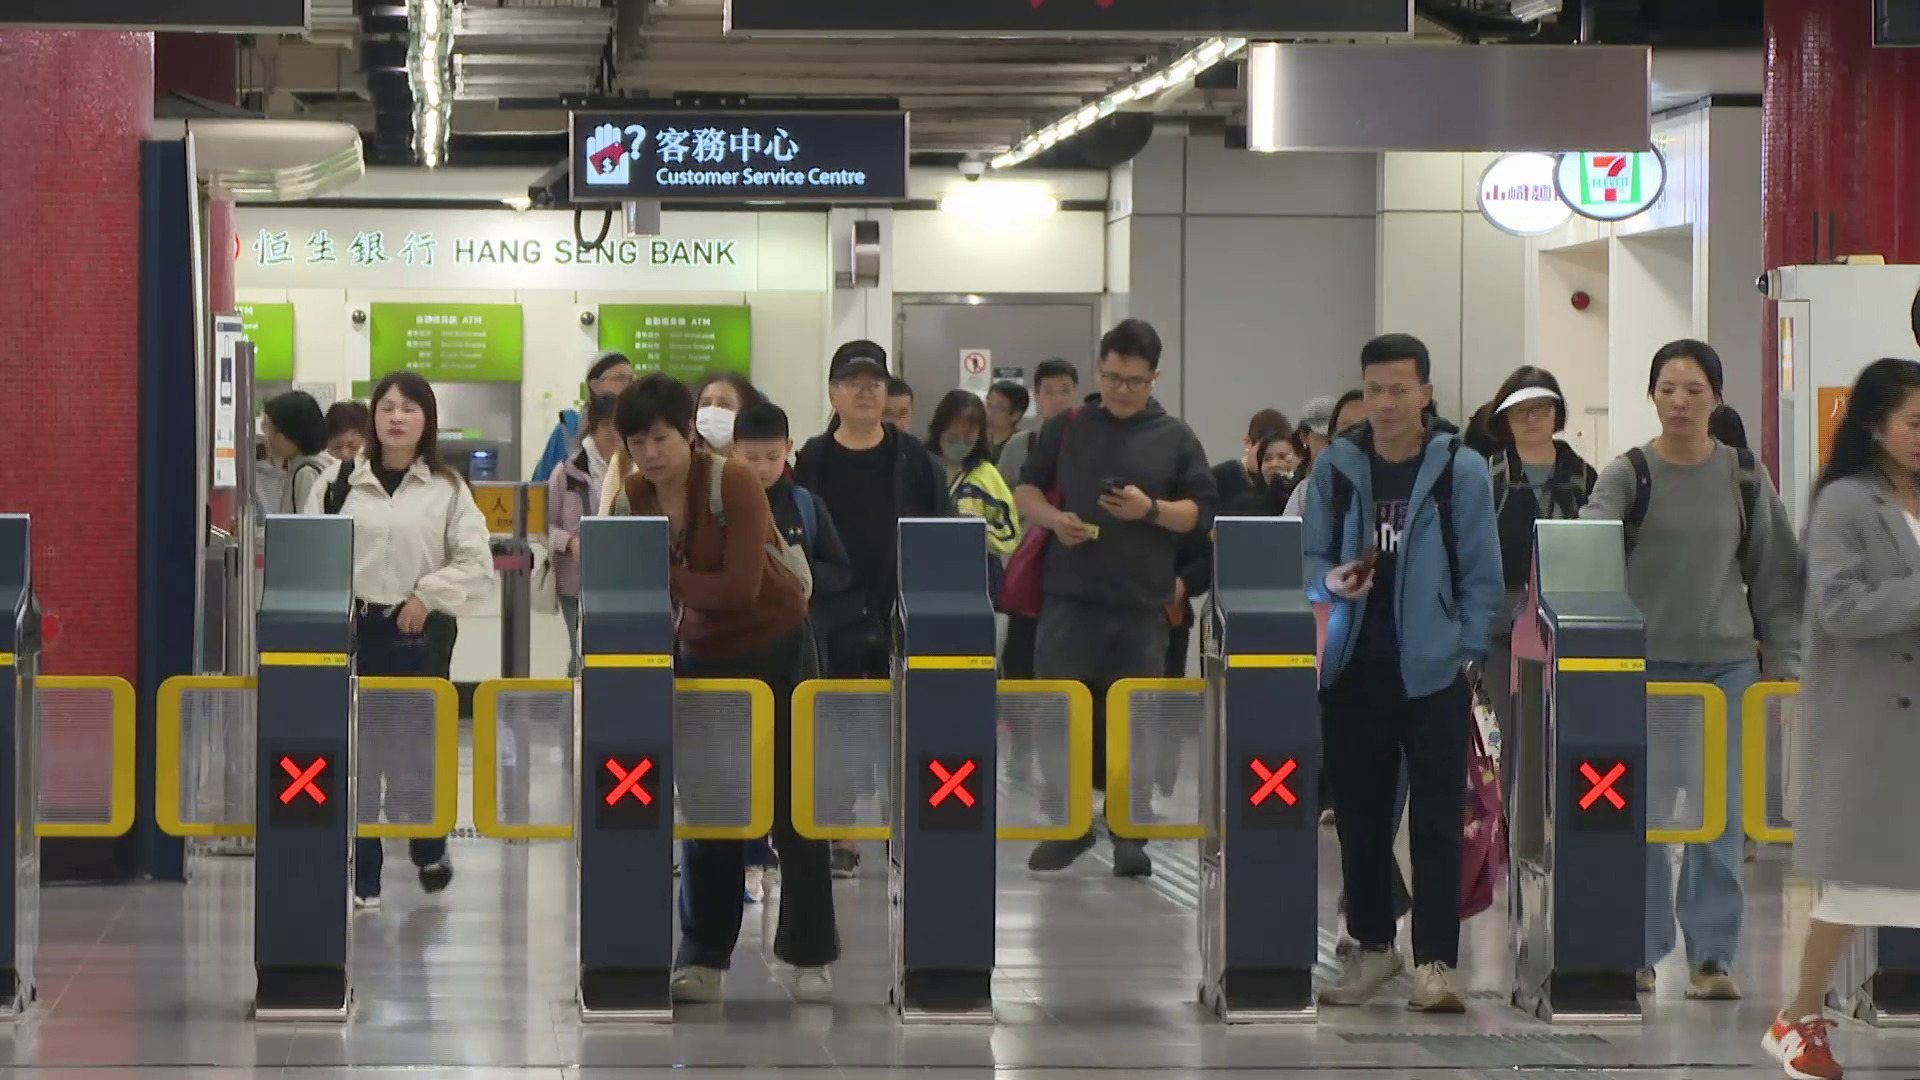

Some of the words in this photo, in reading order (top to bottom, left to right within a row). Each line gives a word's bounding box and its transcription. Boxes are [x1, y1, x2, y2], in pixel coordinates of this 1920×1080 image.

[655, 127, 799, 163] 客務中心
[656, 168, 739, 185] Customer
[743, 168, 803, 185] Service
[808, 168, 866, 185] Centre
[1486, 184, 1558, 201] 山崎麵
[252, 229, 437, 265] 恒生銀行
[455, 240, 541, 263] HANG
[555, 240, 637, 264] SENG
[651, 241, 735, 264] BANK
